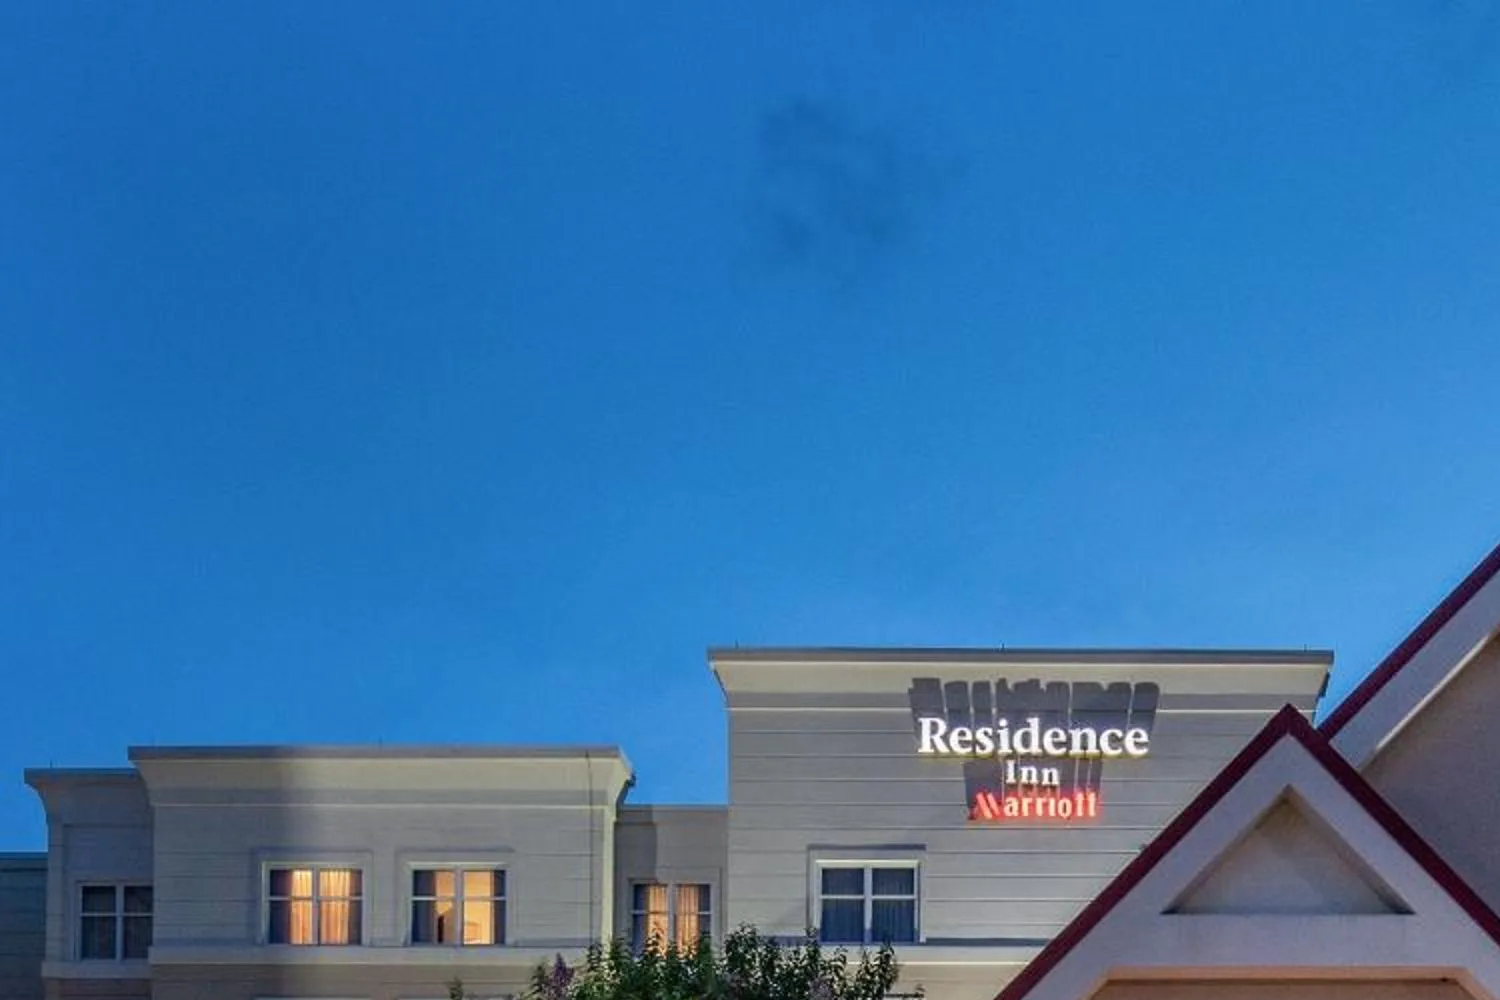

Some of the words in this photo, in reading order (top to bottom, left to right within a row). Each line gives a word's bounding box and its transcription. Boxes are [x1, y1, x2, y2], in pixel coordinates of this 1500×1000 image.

[918, 716, 1149, 755] Residence
[1005, 759, 1060, 785] Inn
[969, 790, 1097, 819] Marriott
